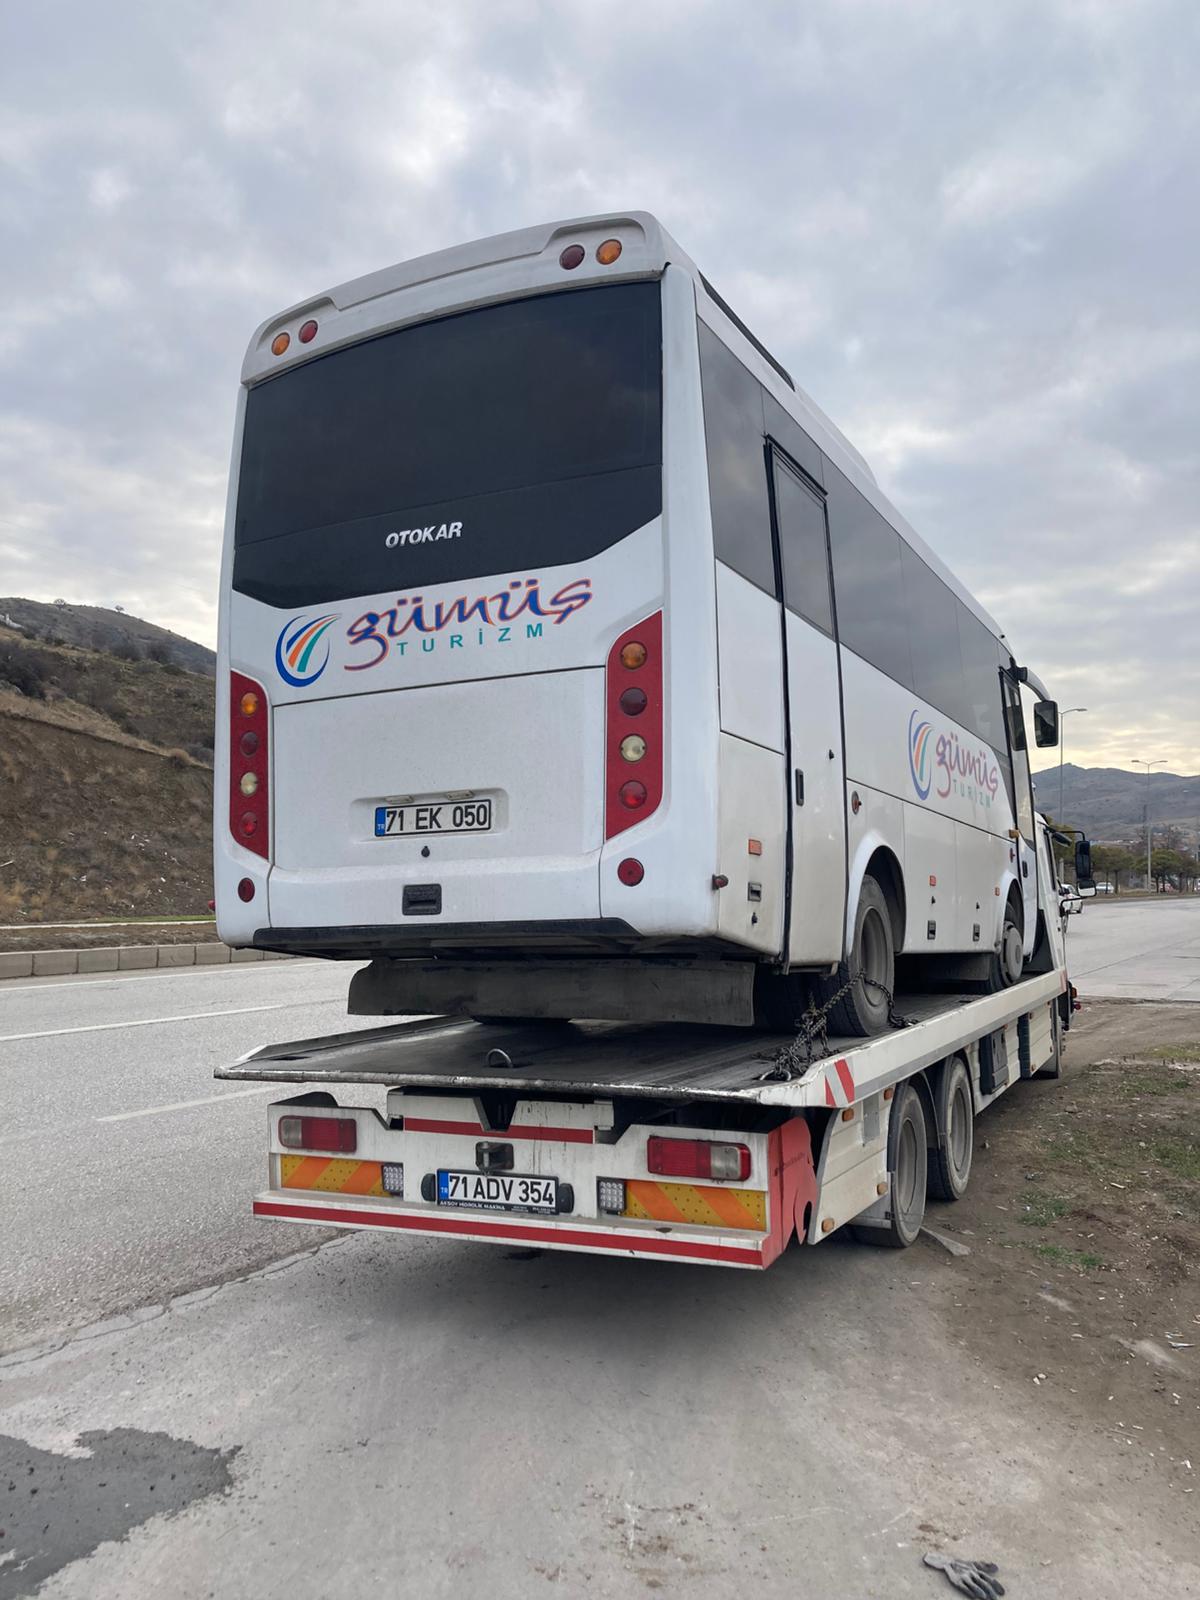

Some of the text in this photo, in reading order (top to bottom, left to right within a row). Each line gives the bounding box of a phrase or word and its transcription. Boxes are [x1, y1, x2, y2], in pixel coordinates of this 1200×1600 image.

[385, 521, 463, 548] OTOKAR
[343, 578, 593, 671] gümüş
[396, 622, 543, 656] TURİZM
[935, 731, 998, 801] gümüş
[386, 803, 488, 832] 71 EK 050
[449, 1175, 554, 1206] 71 ADV 354
